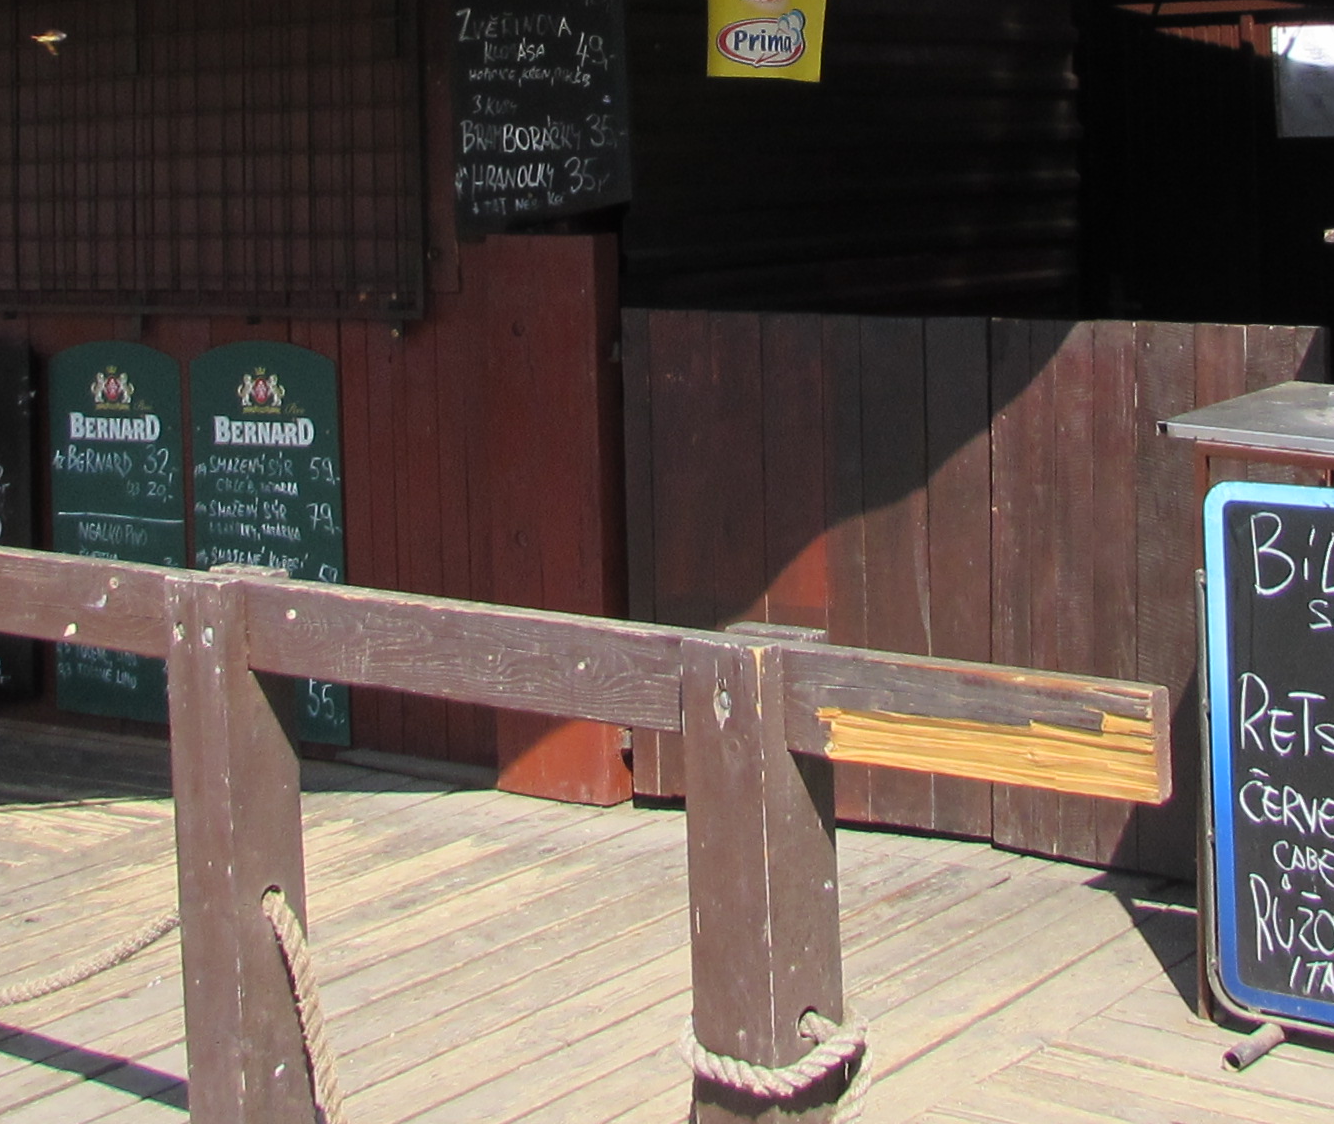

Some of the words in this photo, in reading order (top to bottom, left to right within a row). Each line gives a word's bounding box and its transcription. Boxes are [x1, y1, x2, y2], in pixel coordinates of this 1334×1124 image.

[733, 29, 793, 54] Prima
[69, 411, 161, 442] BERNARD
[213, 415, 316, 447] BERNARD
